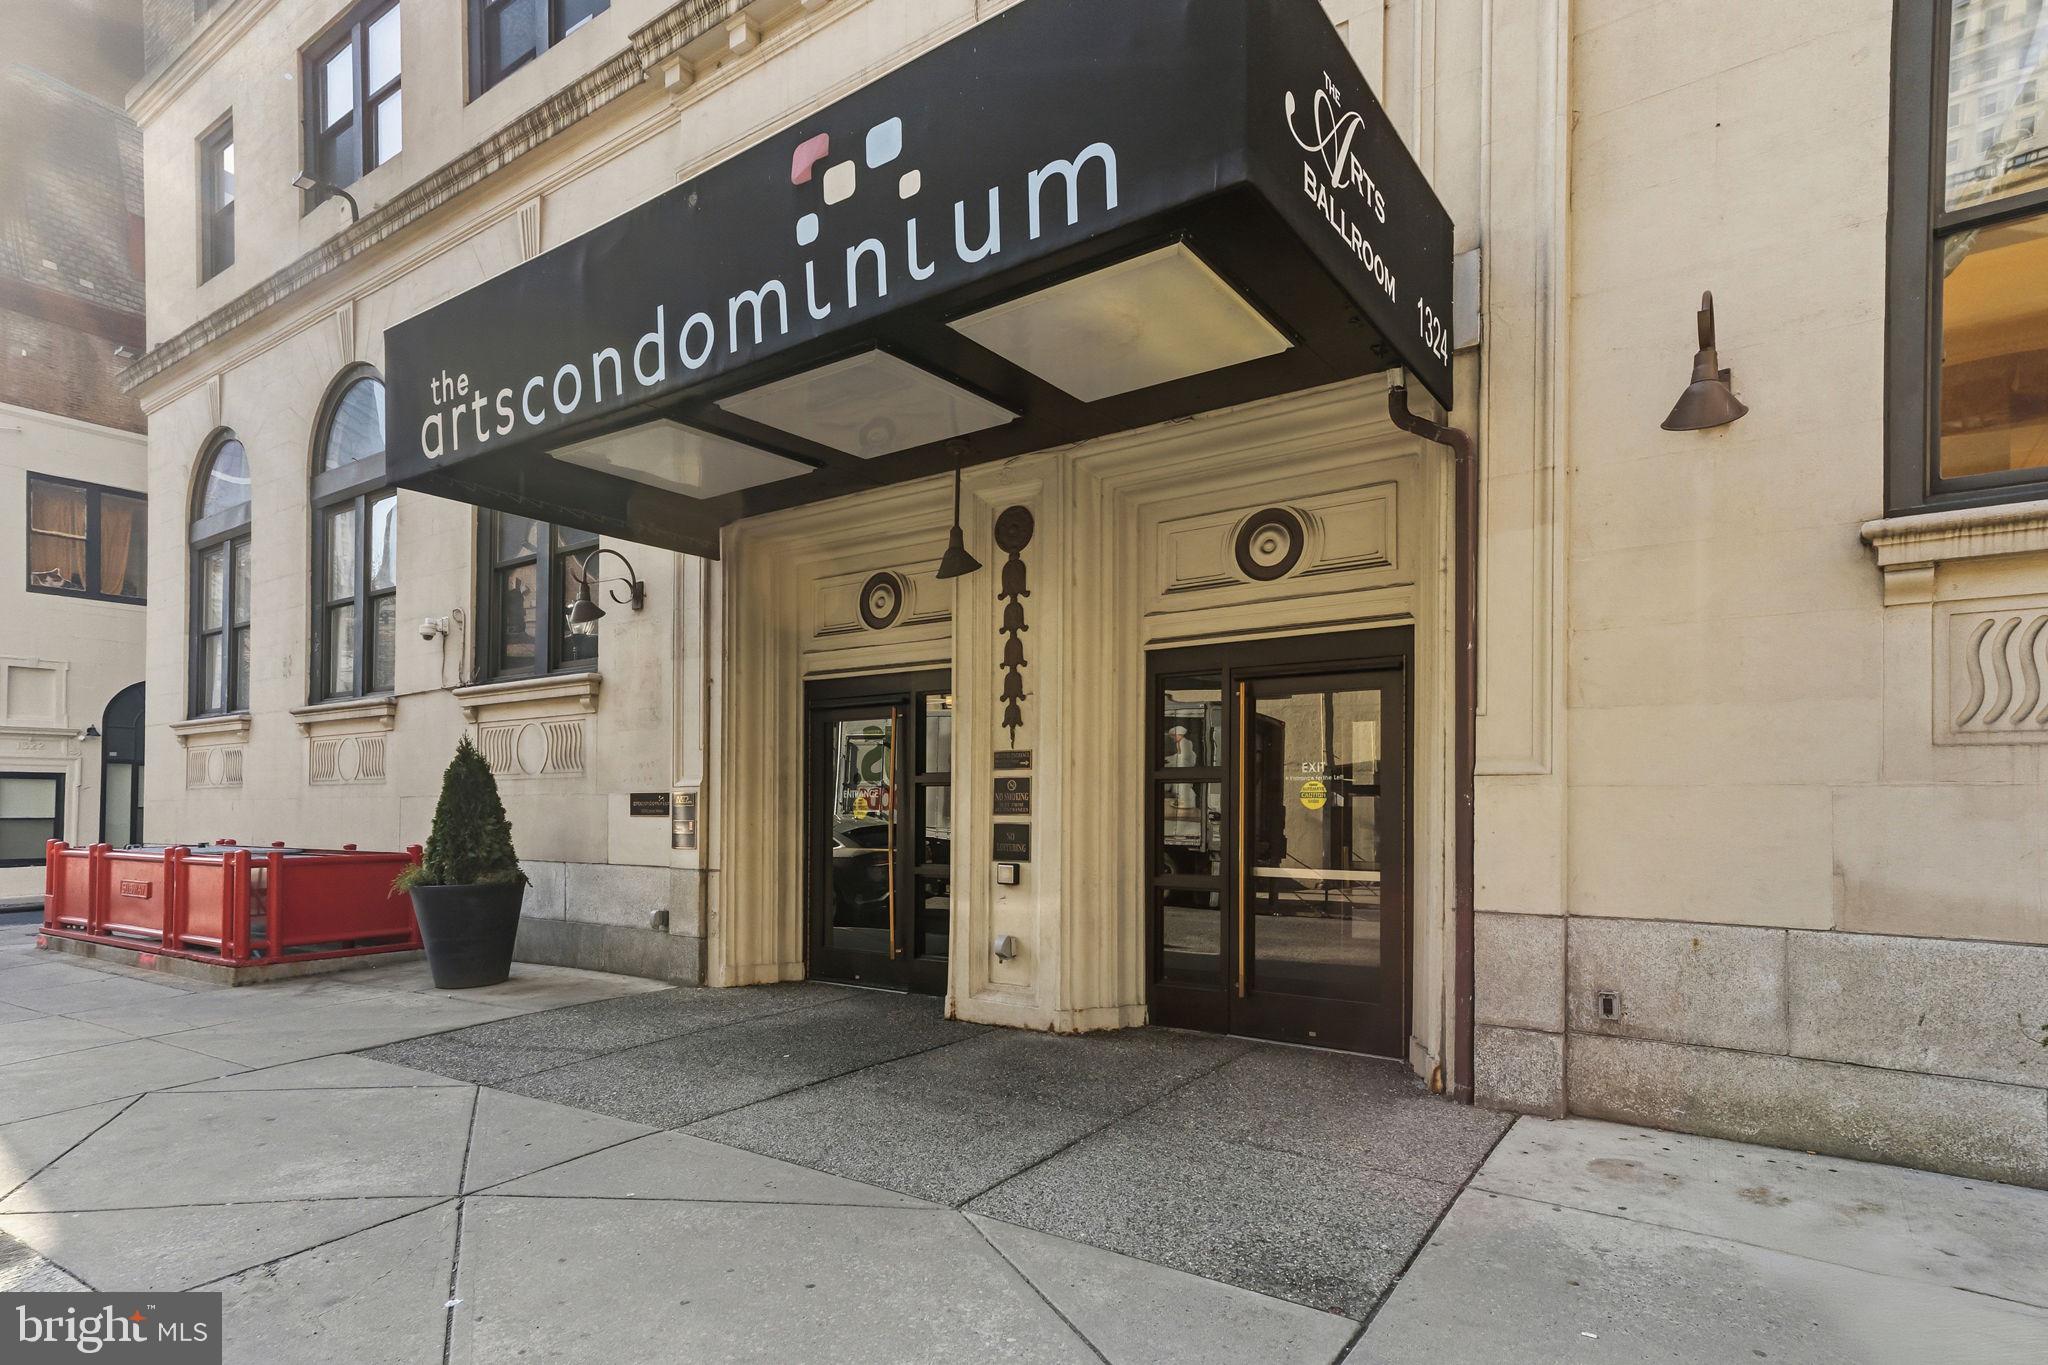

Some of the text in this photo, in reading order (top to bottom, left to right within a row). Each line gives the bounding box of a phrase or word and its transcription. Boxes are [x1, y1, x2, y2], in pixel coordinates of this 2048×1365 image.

[1323, 70, 1341, 107] THE
[1303, 160, 1396, 304] BALLROOM
[1417, 296, 1448, 367] 1324
[430, 369, 470, 406] the
[1302, 761, 1326, 773] EXIT
[843, 790, 880, 799] ENTRANCE
[995, 792, 1004, 801] NO
